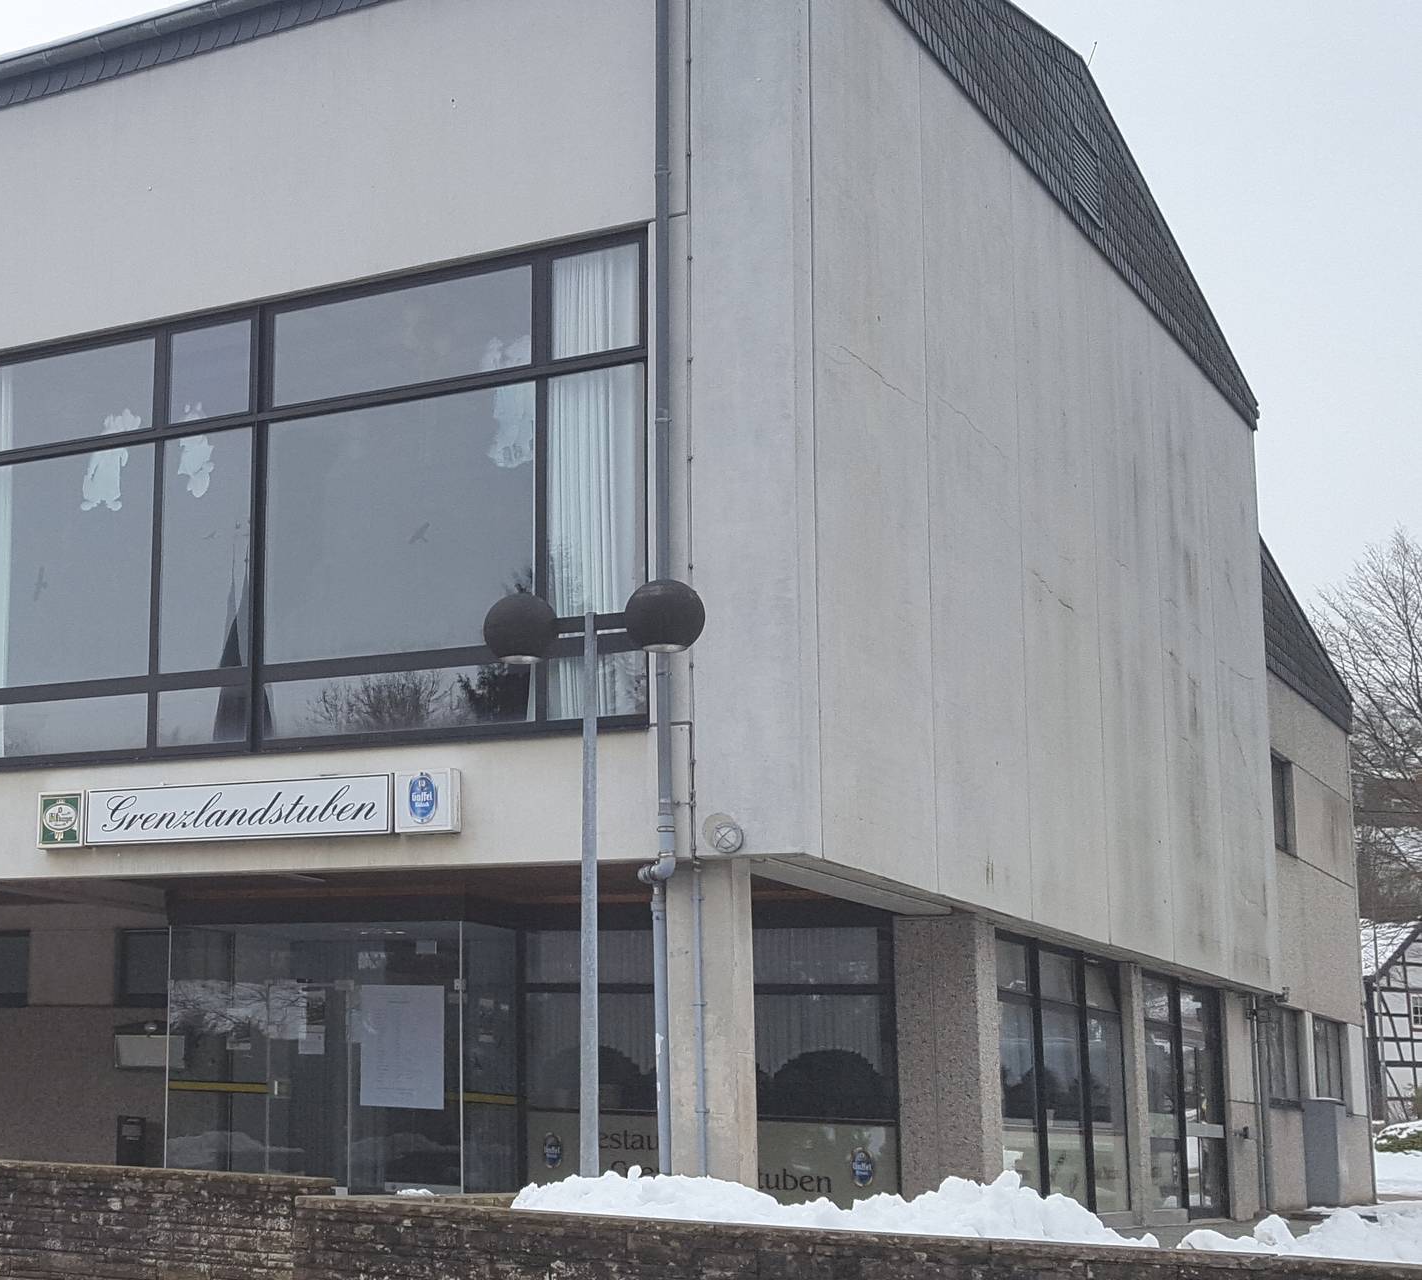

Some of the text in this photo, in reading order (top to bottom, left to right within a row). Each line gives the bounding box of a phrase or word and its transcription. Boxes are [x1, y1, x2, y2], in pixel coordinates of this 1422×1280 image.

[101, 785, 378, 832] Grenzlandstuben
[599, 1130, 659, 1150] estau
[758, 1168, 832, 1193] tuben
